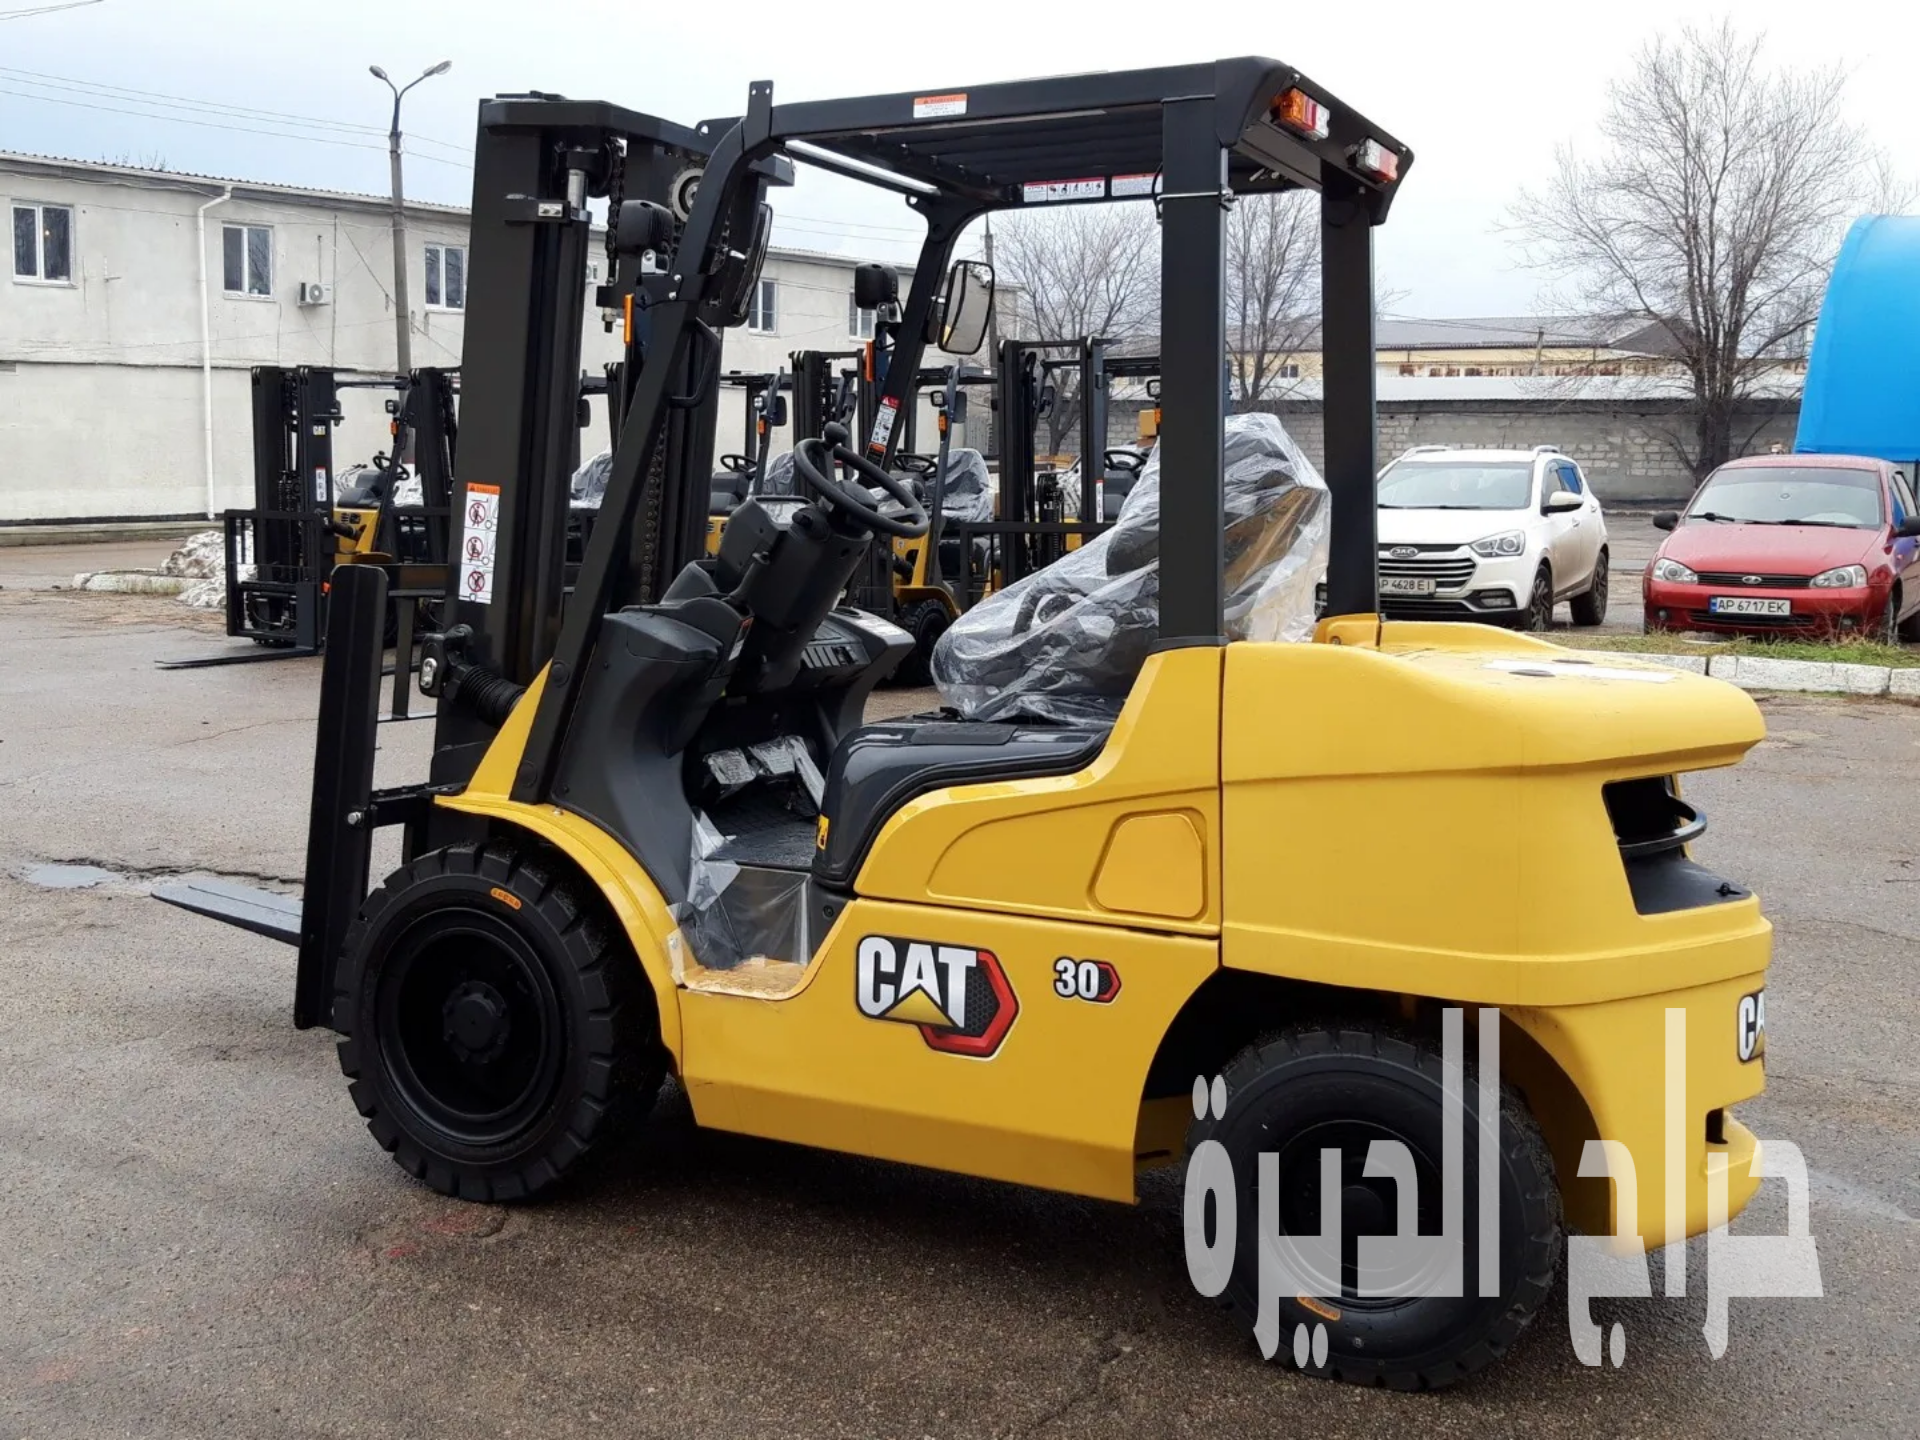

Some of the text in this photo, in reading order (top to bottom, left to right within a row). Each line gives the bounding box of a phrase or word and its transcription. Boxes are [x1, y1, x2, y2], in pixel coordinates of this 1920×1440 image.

[1718, 599, 1786, 613] AP 6717 EK
[857, 936, 977, 1029] CAT
[1055, 958, 1099, 999] 30
[1738, 991, 1765, 1061] CA
